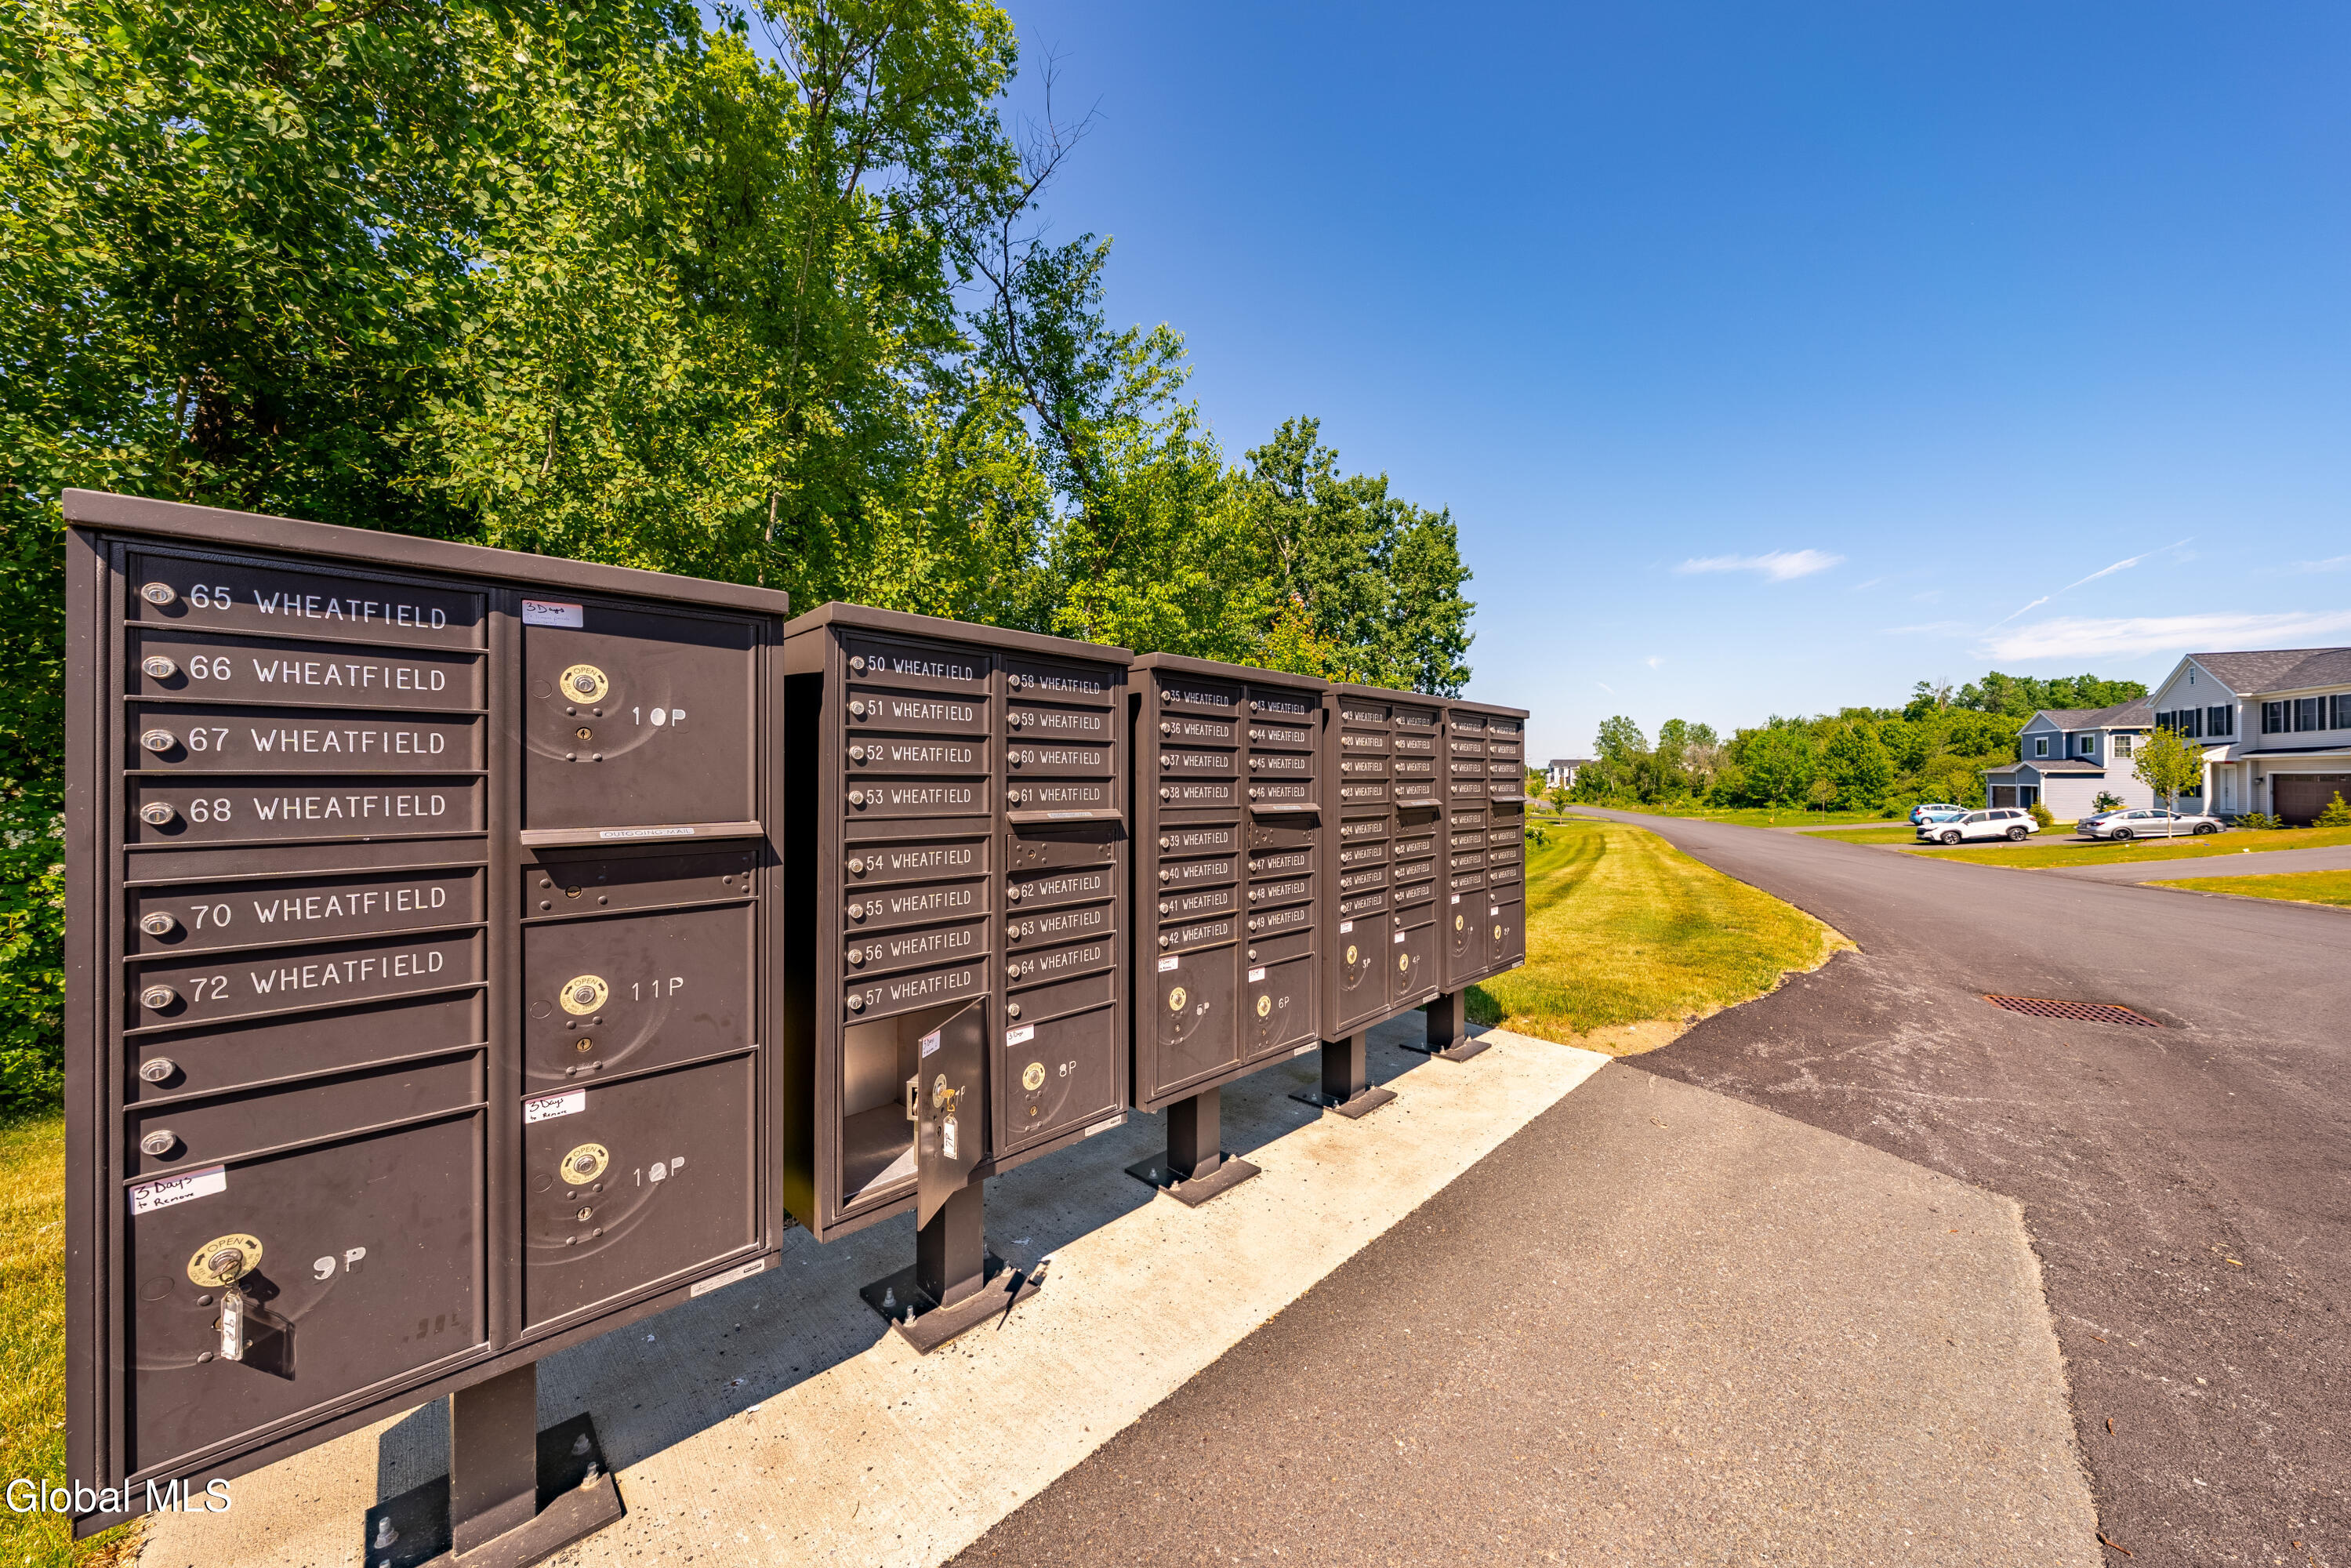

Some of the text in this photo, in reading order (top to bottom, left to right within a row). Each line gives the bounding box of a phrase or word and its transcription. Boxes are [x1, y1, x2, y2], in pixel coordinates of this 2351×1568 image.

[190, 583, 446, 630] 65 WHEATFIELD
[526, 602, 565, 614] 3 Days
[190, 655, 445, 691] 66 WHEATFIELD
[573, 666, 597, 676] OPEN
[868, 655, 973, 681] 50 WHEATFIELD
[1021, 674, 1101, 695] 58 WHEATFIELD
[1170, 690, 1228, 707] 35 WHEATFIELD
[868, 700, 973, 721] 51 WHEATFIELD
[1257, 701, 1304, 716] 43 WHEATFIELD
[1021, 713, 1101, 730] 59 WHEATFIELD
[1355, 711, 1383, 723] WHEATFIELD
[1406, 717, 1430, 727] WHEATFIELD
[1170, 722, 1229, 738] 36 WHEATFIELD
[1257, 729, 1304, 742] 44 WHEATFIELD
[188, 727, 445, 754] 67 WHEATFIELD
[1355, 736, 1383, 747] WHEATFIELD
[1406, 740, 1430, 750] WHEATFIELD
[867, 746, 972, 763] 52 WHEATFIELD
[1459, 743, 1481, 753] WHEATFIELD
[1021, 750, 1101, 765] 60 WHEATFIELD
[1170, 755, 1228, 768] 37 WHEATFIELD
[1257, 758, 1304, 769] 45 WHEATFIELD
[1355, 762, 1382, 771] WHEATFIELD
[1406, 763, 1430, 771] WHEATFIELD
[1459, 764, 1481, 772] WHEATFIELD
[1021, 788, 1100, 802] 61 WHEATFIELD
[1170, 787, 1228, 798] 38 WHEATFIELD
[1257, 786, 1304, 797] 46 WHEATFIELD
[1355, 786, 1382, 797] WHEATFIELD
[1406, 786, 1430, 795] WHEATFIELD
[1459, 784, 1481, 793] WHEATFIELD
[866, 789, 971, 804] 53 WHEATFIELD
[190, 794, 445, 822] 68 WHEATFIELD
[1459, 815, 1481, 824] WHEATFIELD
[1355, 823, 1382, 834] WHEATFIELD
[1170, 832, 1228, 847] 39 WHEATFIELD
[1406, 840, 1430, 852] WHEATFIELD
[1459, 834, 1481, 845] WHEATFIELD
[866, 849, 971, 871] 54 WHEATFIELD
[1355, 847, 1382, 859] WHEATFIELD
[1257, 855, 1304, 869] 47 WHEATFIELD
[1459, 855, 1481, 866] WHEATFIELD
[1169, 862, 1228, 879] 40 WHEATFIELD
[1406, 863, 1430, 875] WHEATFIELD
[1355, 871, 1382, 884] WHEATFIELD
[1021, 876, 1101, 898] 62 WHEATFIELD
[1257, 882, 1304, 898] 48 WHEATFIELD
[1406, 886, 1429, 899] WHEATFIELD
[190, 887, 446, 929] 70 WHEATFIELD
[866, 890, 971, 916] 55 WHEATFIELD
[1169, 893, 1228, 912] 41 WHEATFIELD
[1354, 895, 1382, 909] WHEATFIELD
[1021, 911, 1101, 935] 63 WHEATFIELD
[1257, 909, 1304, 927] 49 WHEATFIELD
[1169, 923, 1228, 944] 42 WHEATFIELD
[865, 931, 971, 961] 56 WHEATFIELD
[1021, 946, 1101, 975] 64 WHEATFIELD
[190, 950, 444, 1002] 72 WHEATFIELD
[574, 978, 598, 986] OPEN
[865, 971, 971, 1006] 57 WHEATFIELD
[1279, 996, 1290, 1008] 6P
[529, 1098, 564, 1112] 3 Days
[573, 1146, 597, 1157] OPEN
[134, 1177, 192, 1200] 3 Days
[207, 1237, 244, 1253] OPEN
